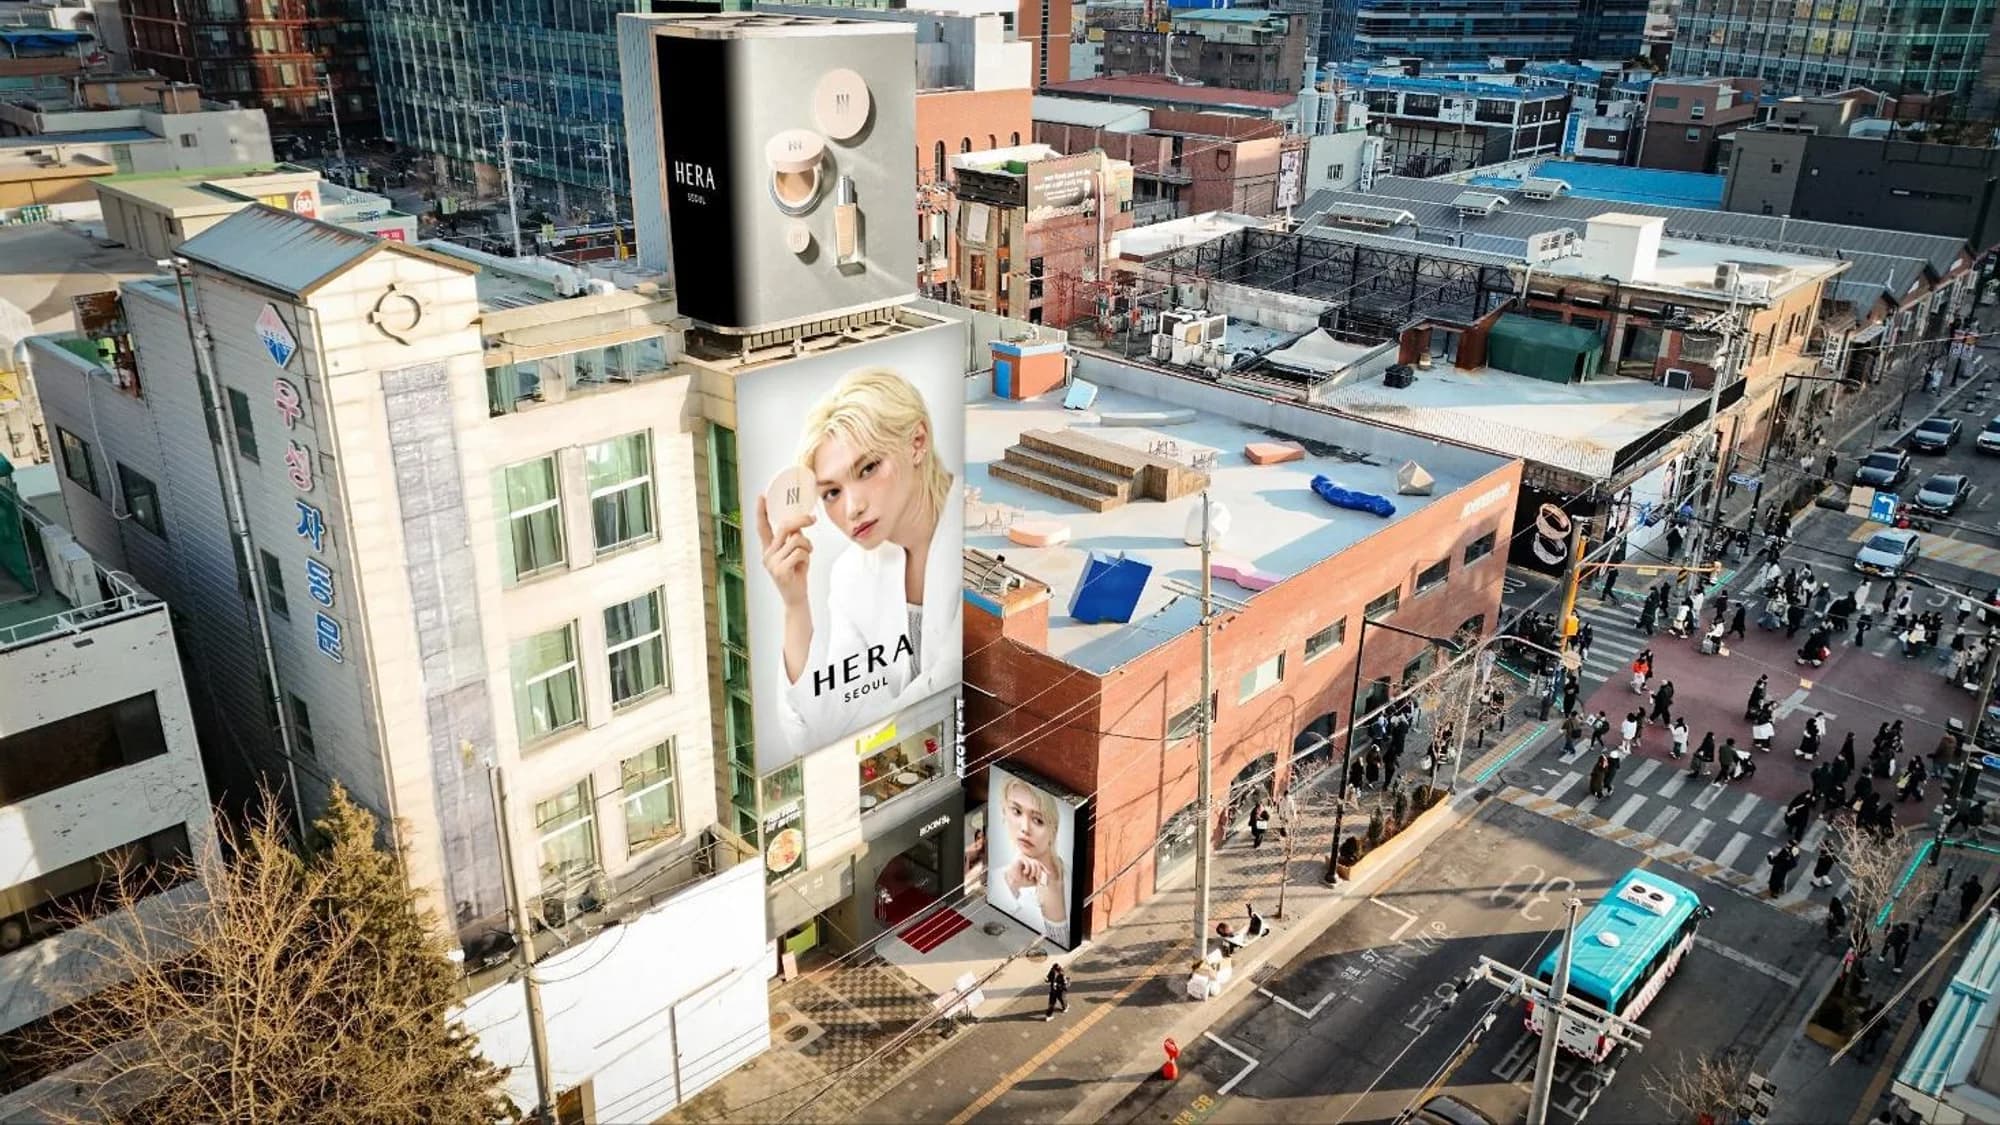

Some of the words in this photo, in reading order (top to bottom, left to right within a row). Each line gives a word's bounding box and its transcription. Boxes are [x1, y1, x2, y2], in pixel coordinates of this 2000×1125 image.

[674, 160, 716, 190] HERA
[687, 192, 706, 205] SEOUL
[271, 377, 344, 664] 우성자동문
[813, 633, 914, 697] HERA
[844, 676, 889, 703] SEOUL
[1360, 948, 1379, 963] 57
